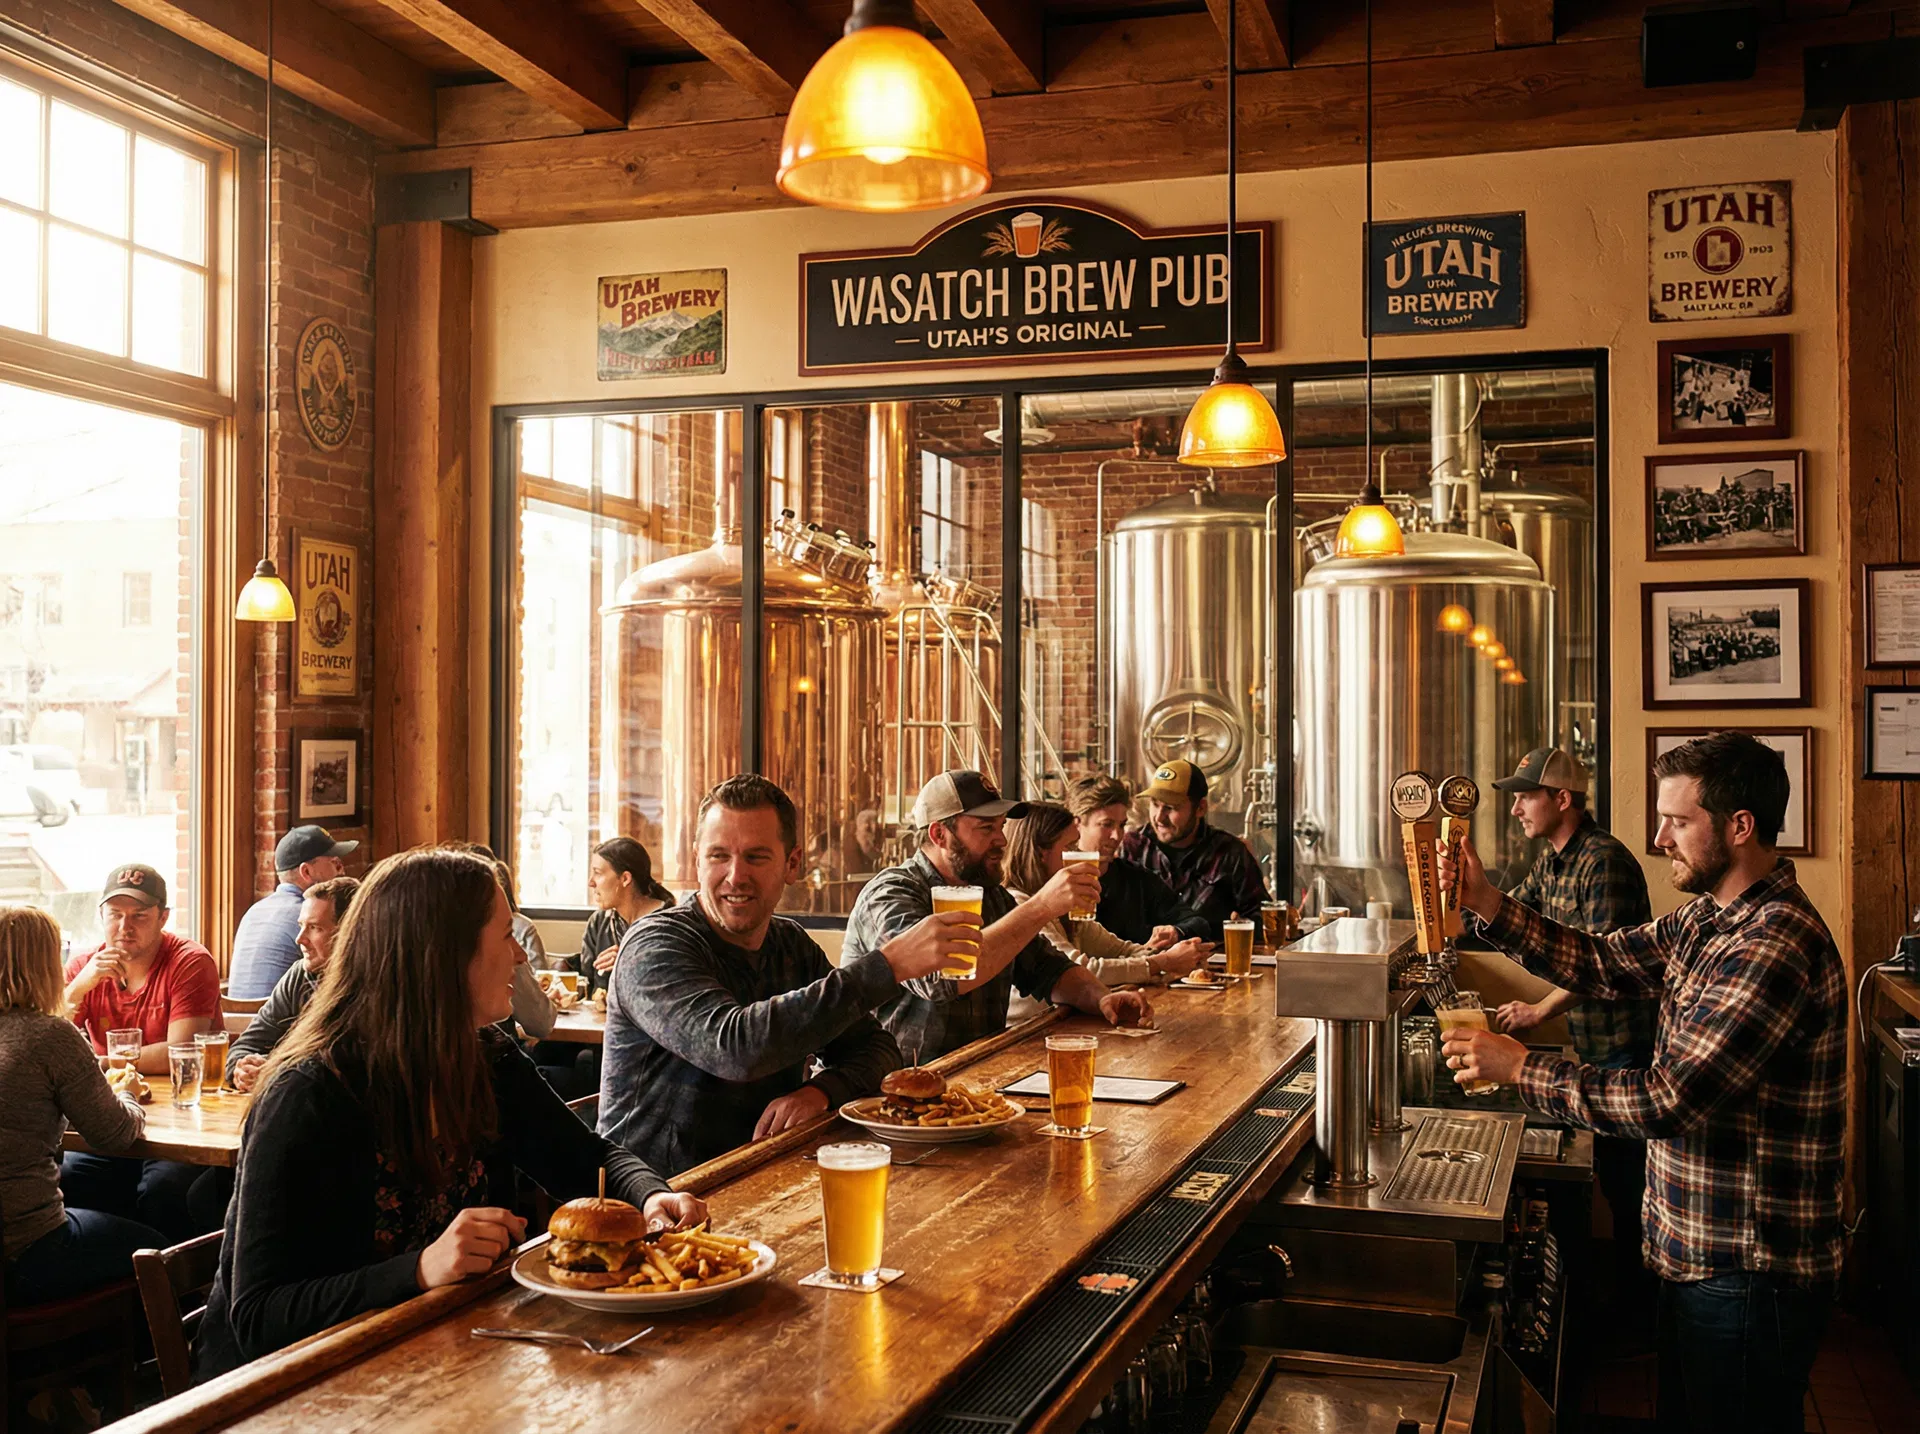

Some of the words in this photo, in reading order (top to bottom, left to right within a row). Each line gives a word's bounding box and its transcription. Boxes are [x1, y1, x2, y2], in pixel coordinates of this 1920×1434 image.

[1662, 192, 1775, 233] UTAH
[1384, 239, 1501, 289] UTAH
[603, 277, 660, 309] UTAH
[831, 267, 1009, 327] WASATCH
[1025, 259, 1137, 315] BREW
[1151, 254, 1229, 308] PUB
[1387, 289, 1499, 315] BREWERY
[1661, 276, 1778, 302] BREWERY
[621, 289, 720, 329] BREWERY
[1684, 304, 1706, 313] SALT
[927, 327, 1009, 349] UTAH'S
[1017, 321, 1132, 344] ORIGINAL
[306, 551, 351, 595] UTAH
[301, 651, 352, 670] BREWERY
